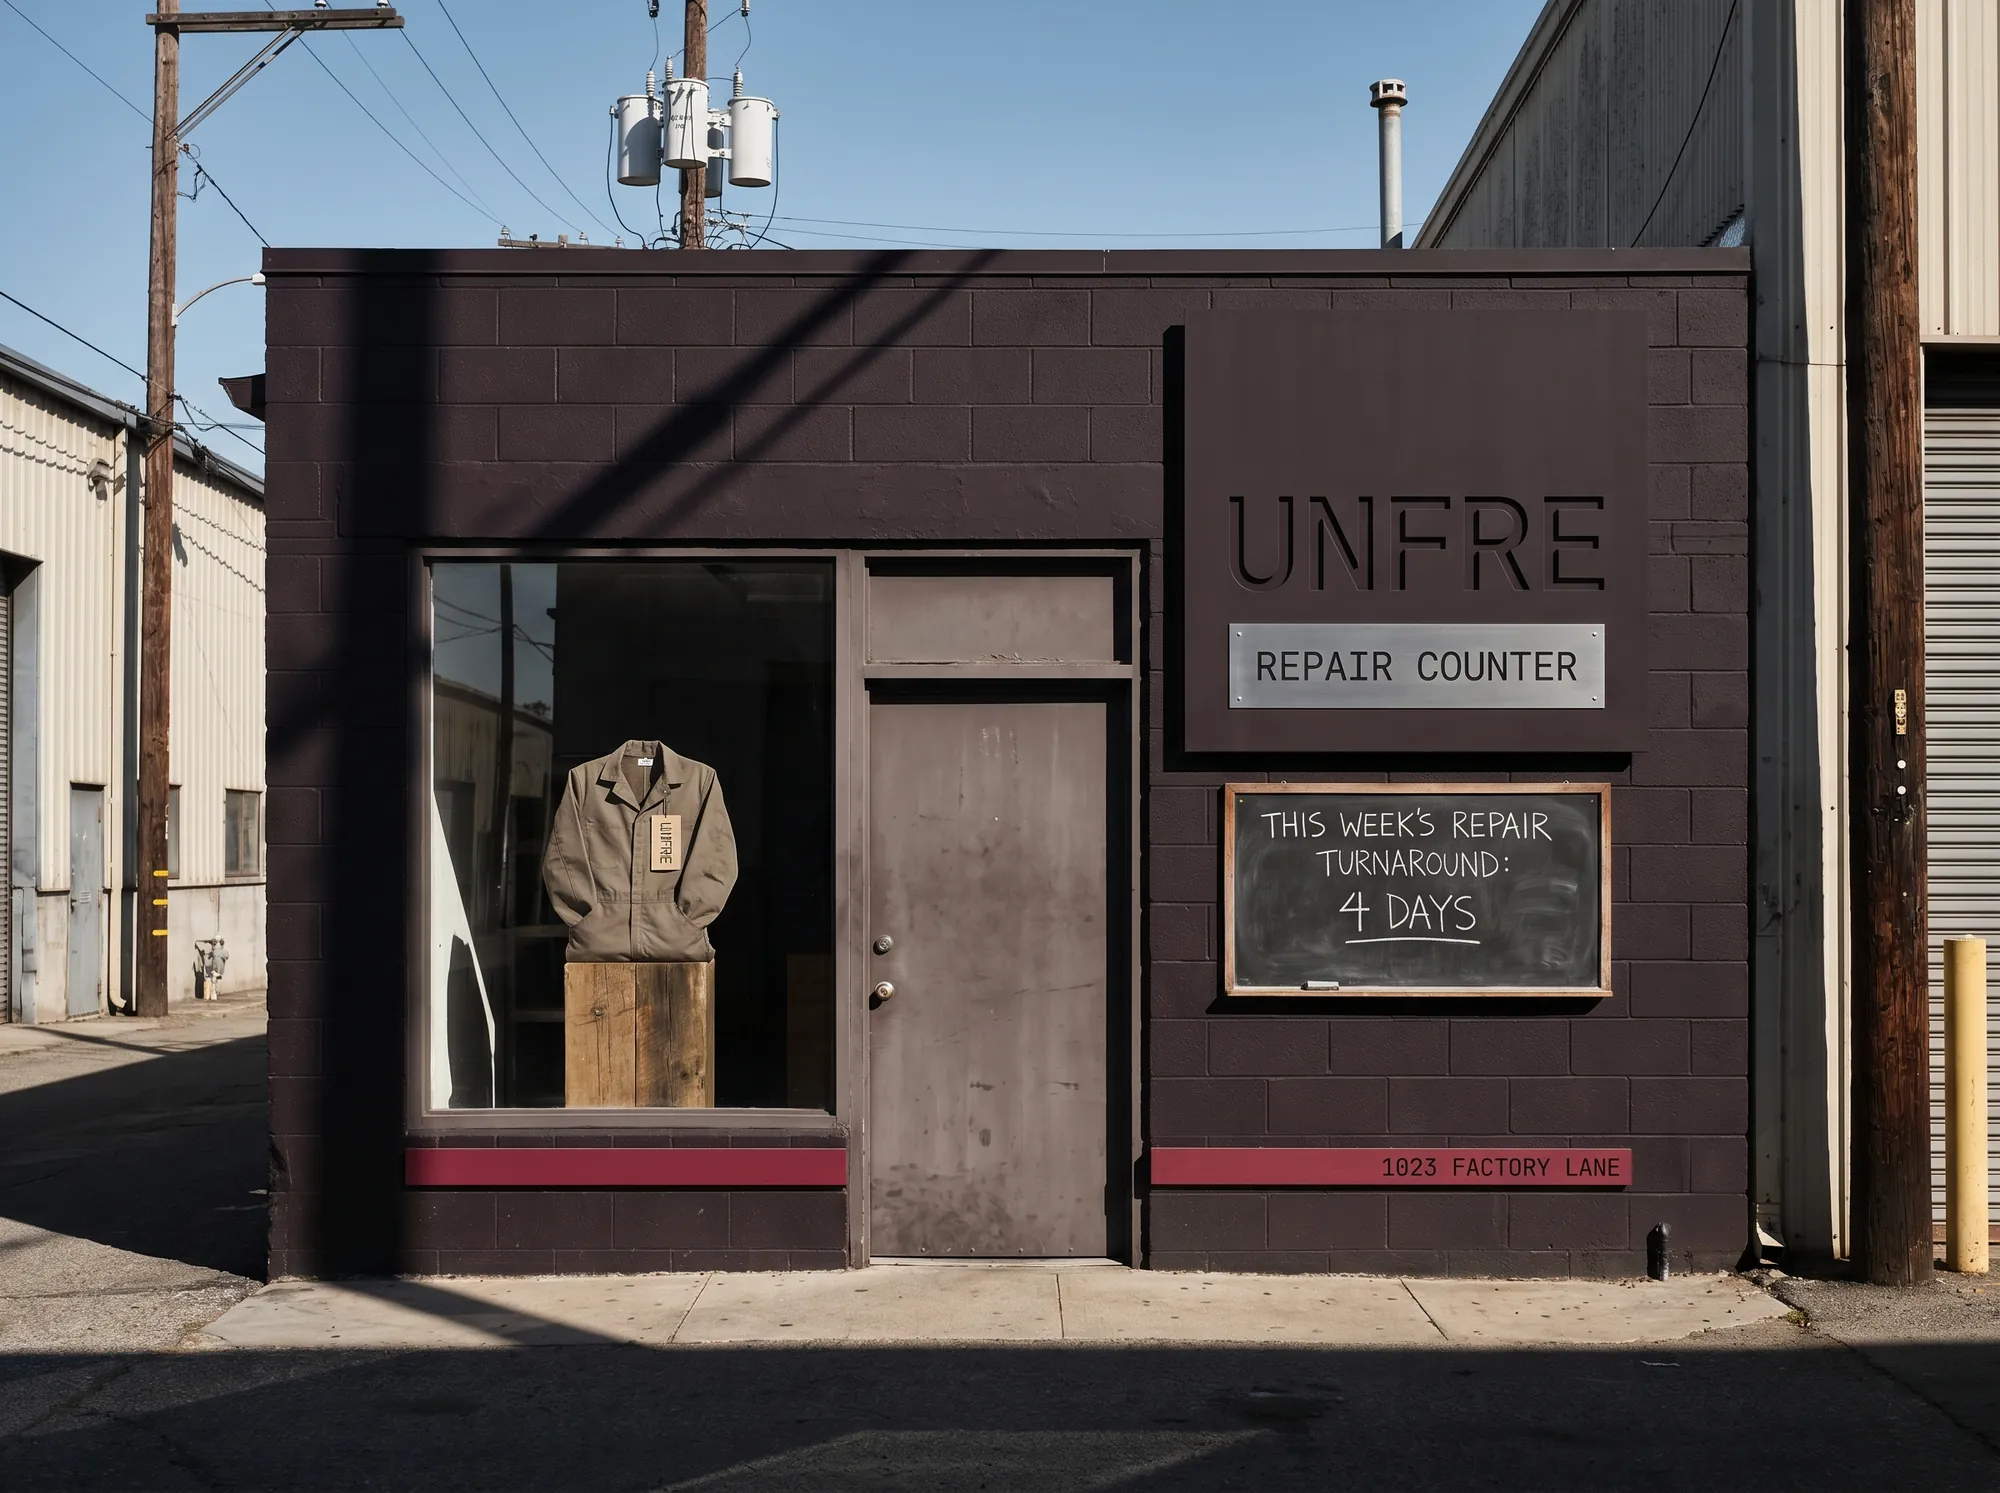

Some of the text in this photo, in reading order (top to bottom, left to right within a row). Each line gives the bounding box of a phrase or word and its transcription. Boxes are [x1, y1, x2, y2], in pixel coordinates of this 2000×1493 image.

[1228, 495, 1605, 594] UNFRE
[1257, 651, 1577, 681] REPAIR COUNTER
[1261, 807, 1553, 841] THIS WEEK'S REPAIR
[1316, 849, 1510, 878] TURNAROUND:
[1339, 891, 1477, 932] 4 DAYS
[1382, 1158, 1620, 1177] 1023 FACTORY LANE
